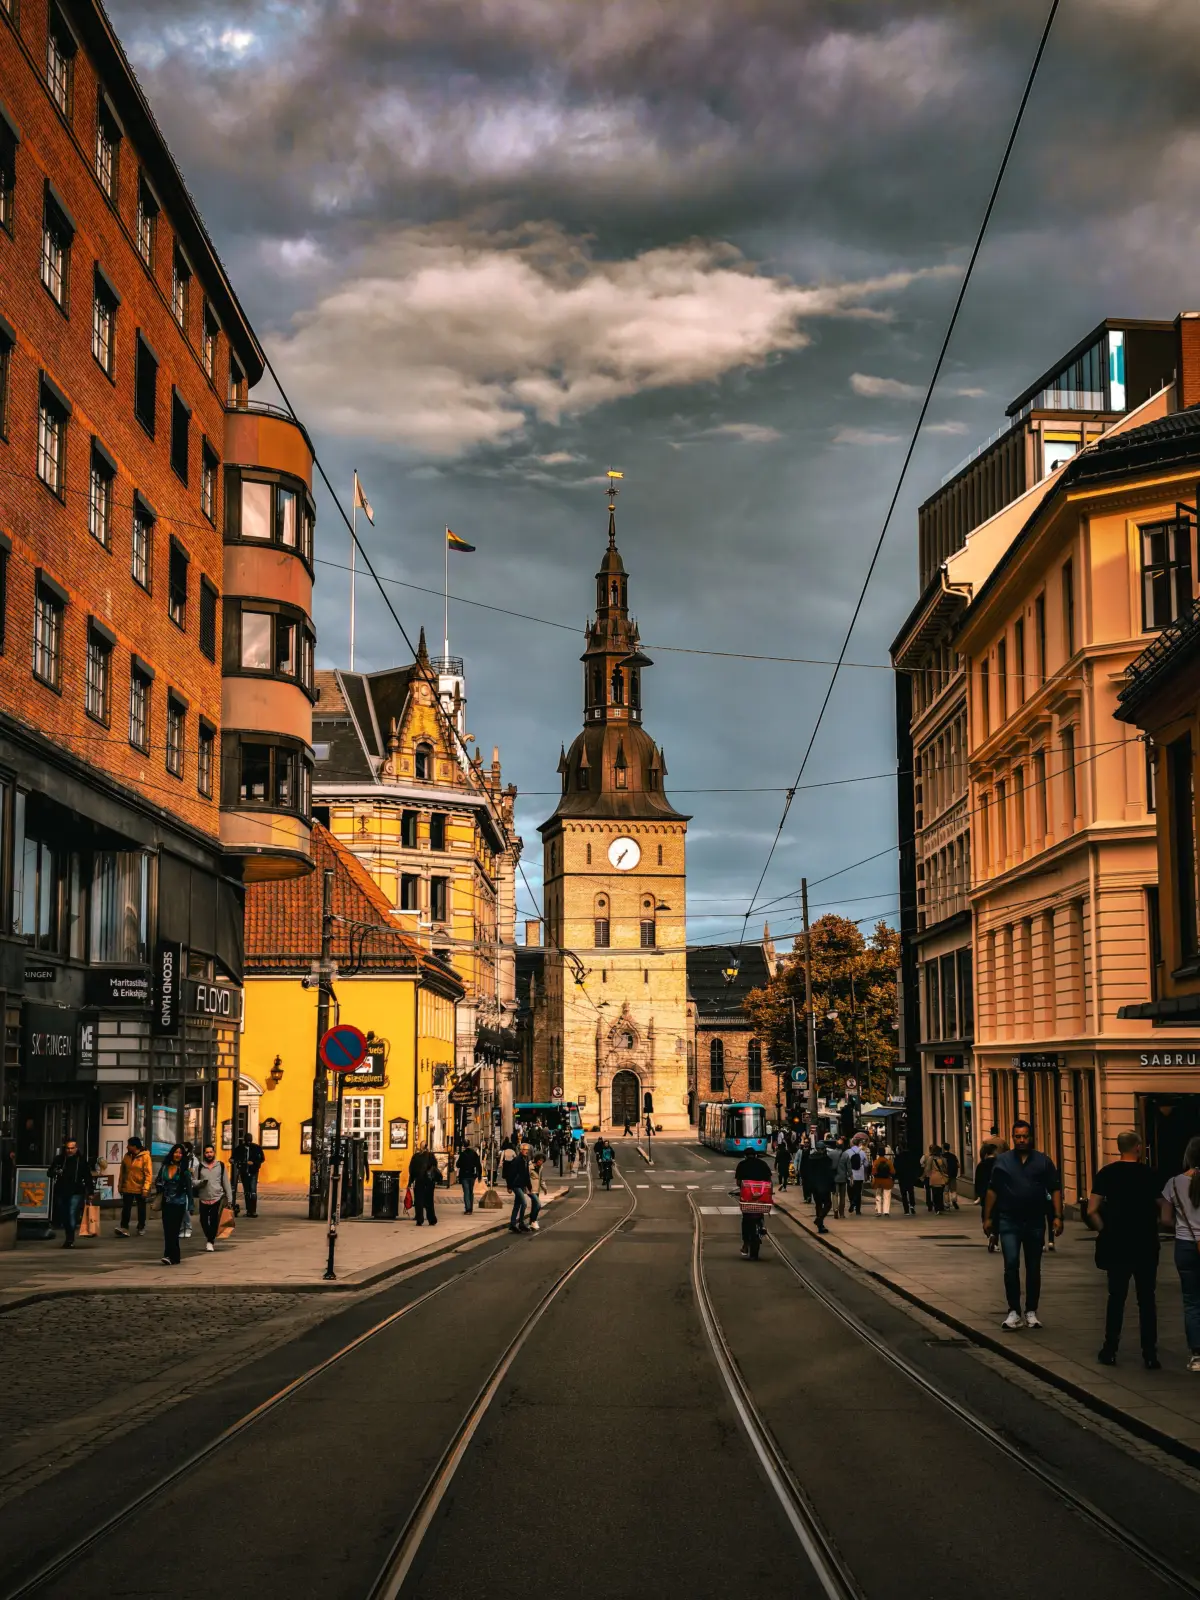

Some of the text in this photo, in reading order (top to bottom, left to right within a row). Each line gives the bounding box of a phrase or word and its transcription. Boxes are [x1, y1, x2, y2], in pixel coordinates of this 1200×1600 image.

[112, 988, 119, 997] &
[161, 951, 173, 1026] SECOND HAND
[197, 985, 230, 1015] FLOYD
[1140, 1053, 1196, 1066] SABRU
